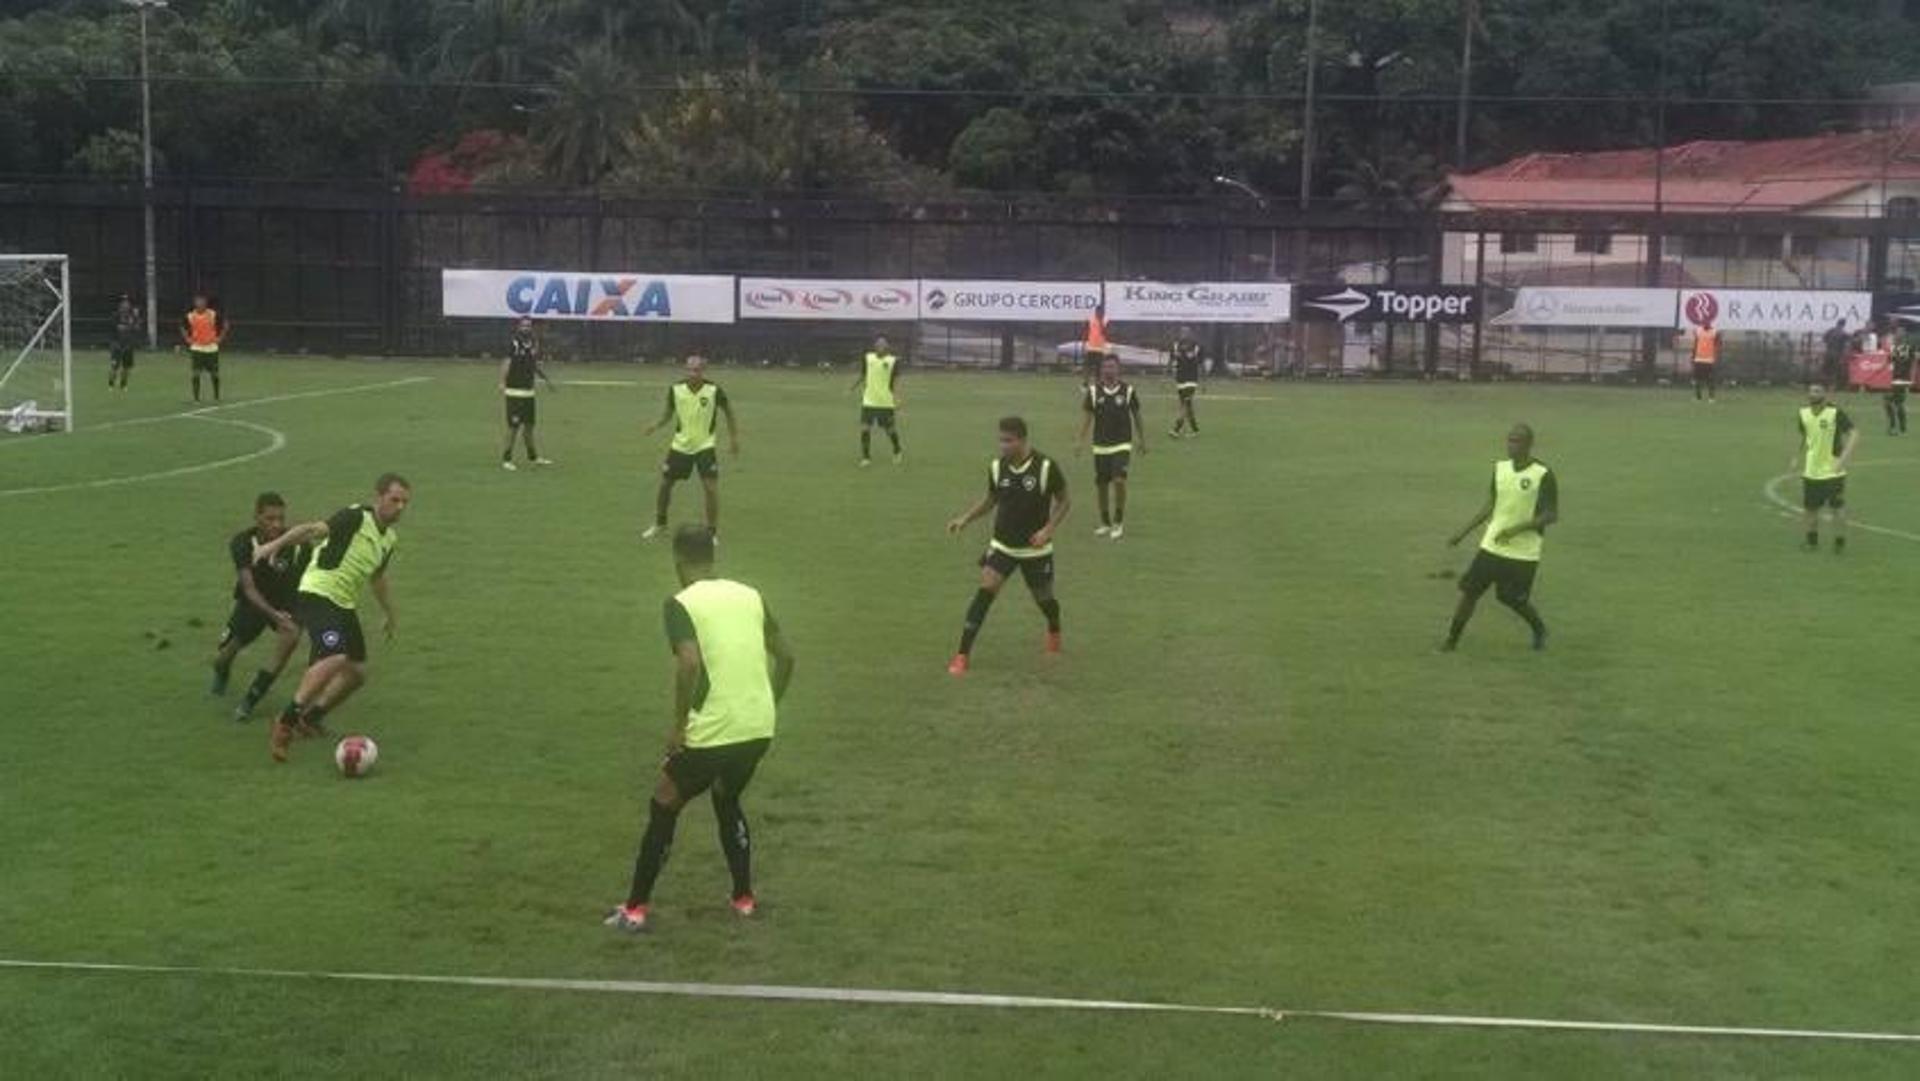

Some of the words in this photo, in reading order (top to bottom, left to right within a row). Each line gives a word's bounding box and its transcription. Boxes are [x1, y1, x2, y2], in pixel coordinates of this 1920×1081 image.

[506, 274, 672, 317] CAIXA
[953, 291, 1015, 308] GRUPO
[1016, 293, 1097, 310] CERCRED
[1376, 290, 1473, 320] Topper
[1727, 301, 1861, 321] RAMADA
